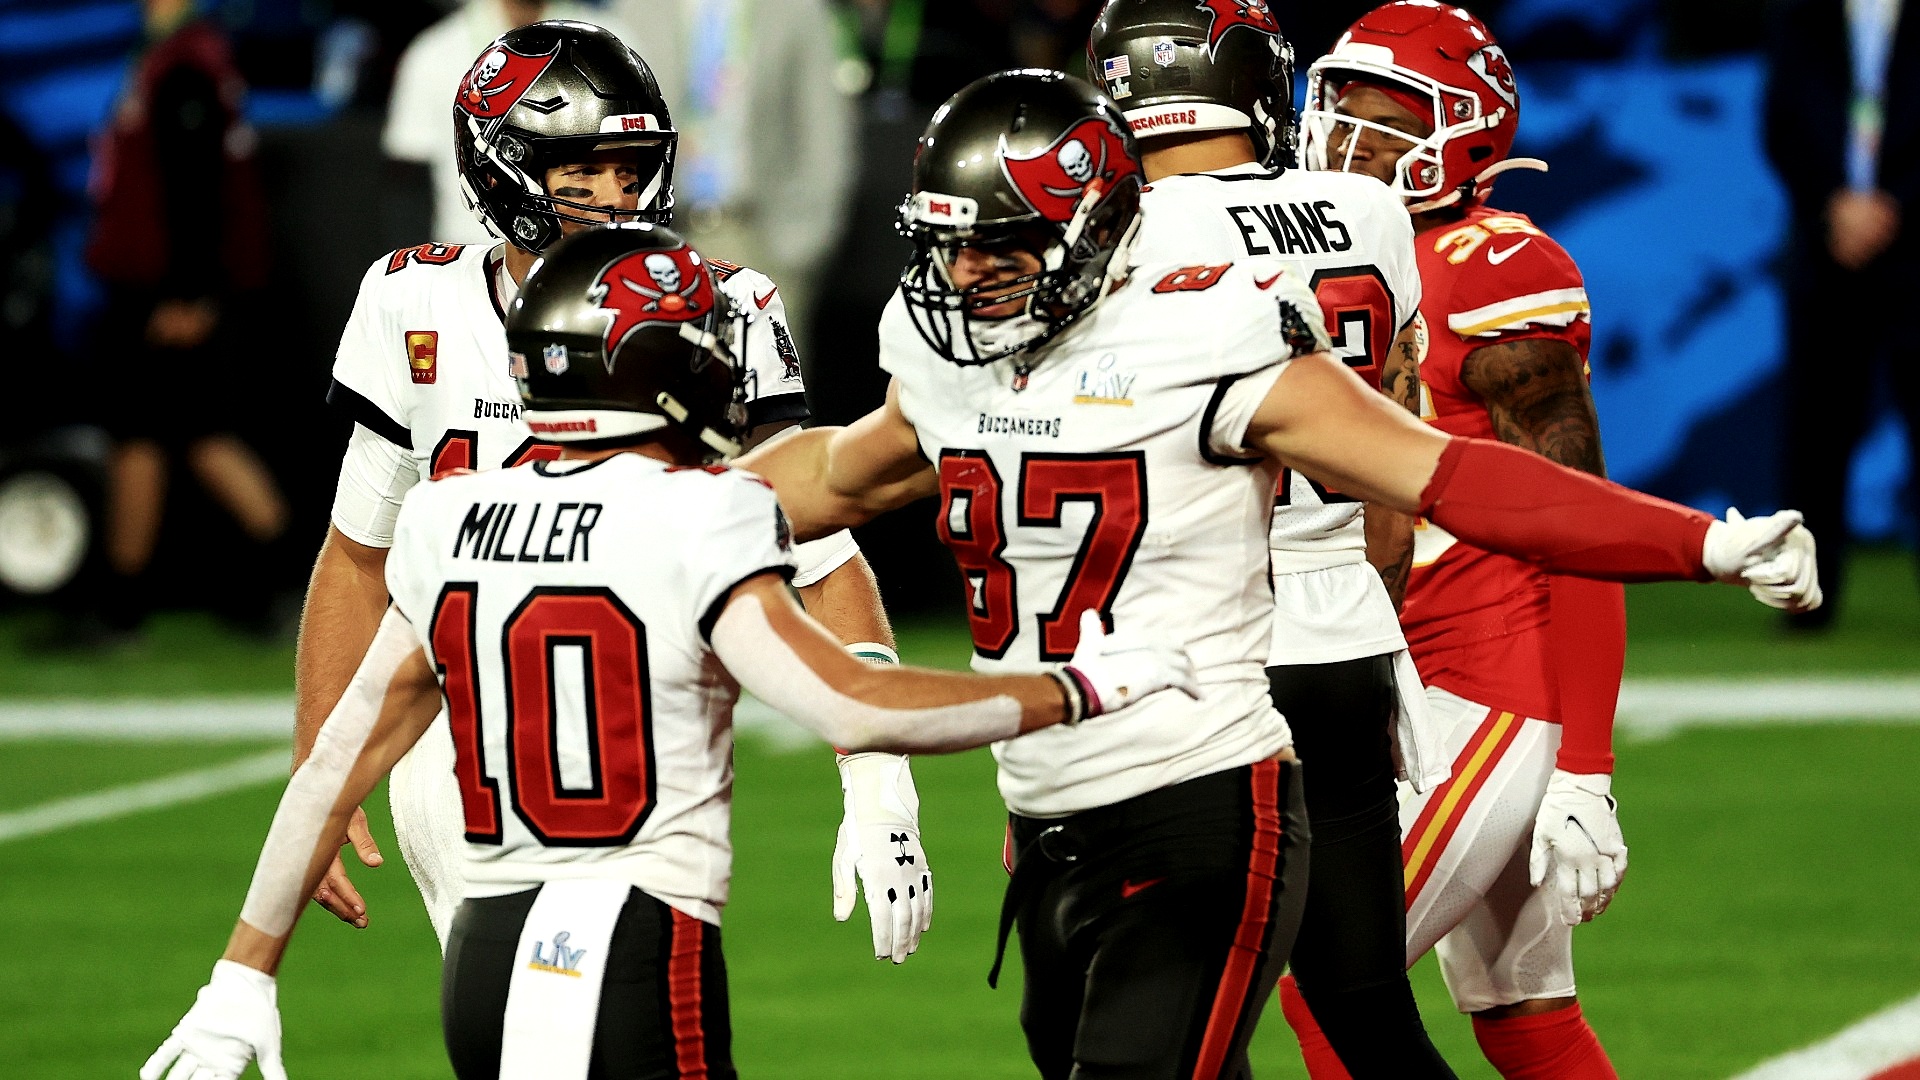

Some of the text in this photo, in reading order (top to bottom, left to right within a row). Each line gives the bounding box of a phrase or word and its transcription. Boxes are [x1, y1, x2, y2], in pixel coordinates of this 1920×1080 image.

[1157, 51, 1173, 63] NFL
[1227, 201, 1352, 257] EVANS
[408, 334, 434, 370] C
[977, 413, 1061, 438] BUCCANEERS
[452, 502, 603, 563] MILLER
[935, 447, 1149, 662] 87
[430, 581, 658, 847] 10
